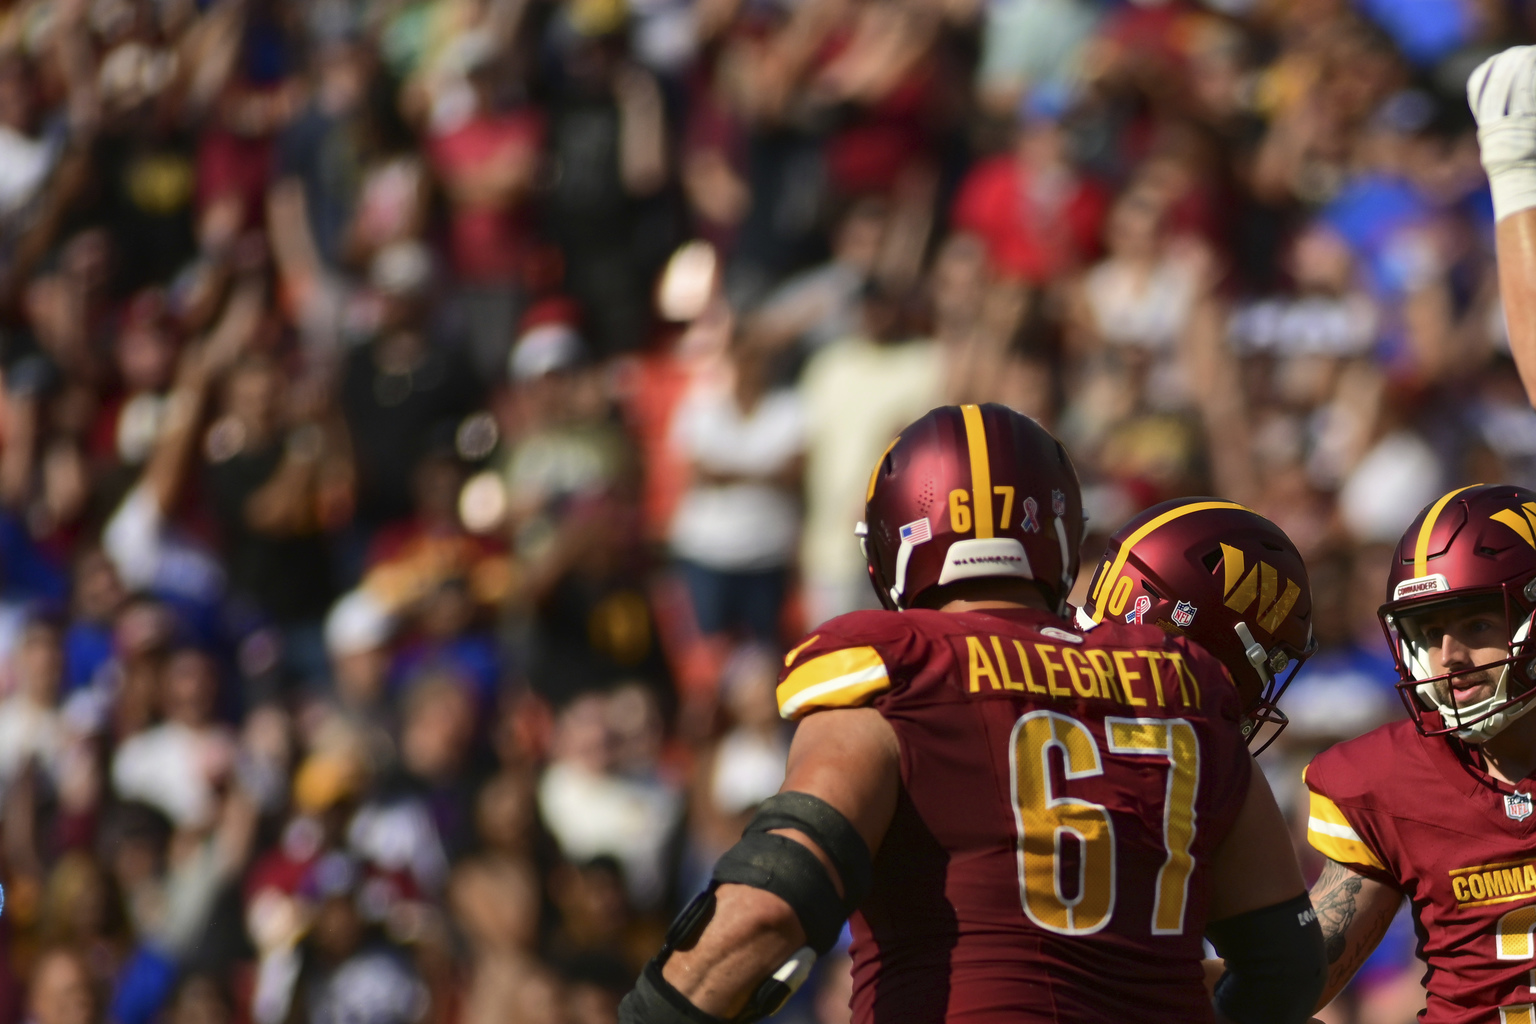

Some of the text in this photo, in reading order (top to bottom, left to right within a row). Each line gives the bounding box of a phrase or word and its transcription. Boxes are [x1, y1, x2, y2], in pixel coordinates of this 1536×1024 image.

[1175, 611, 1191, 624] NFL
[1510, 803, 1529, 816] NFL
[1009, 709, 1199, 937] 67
